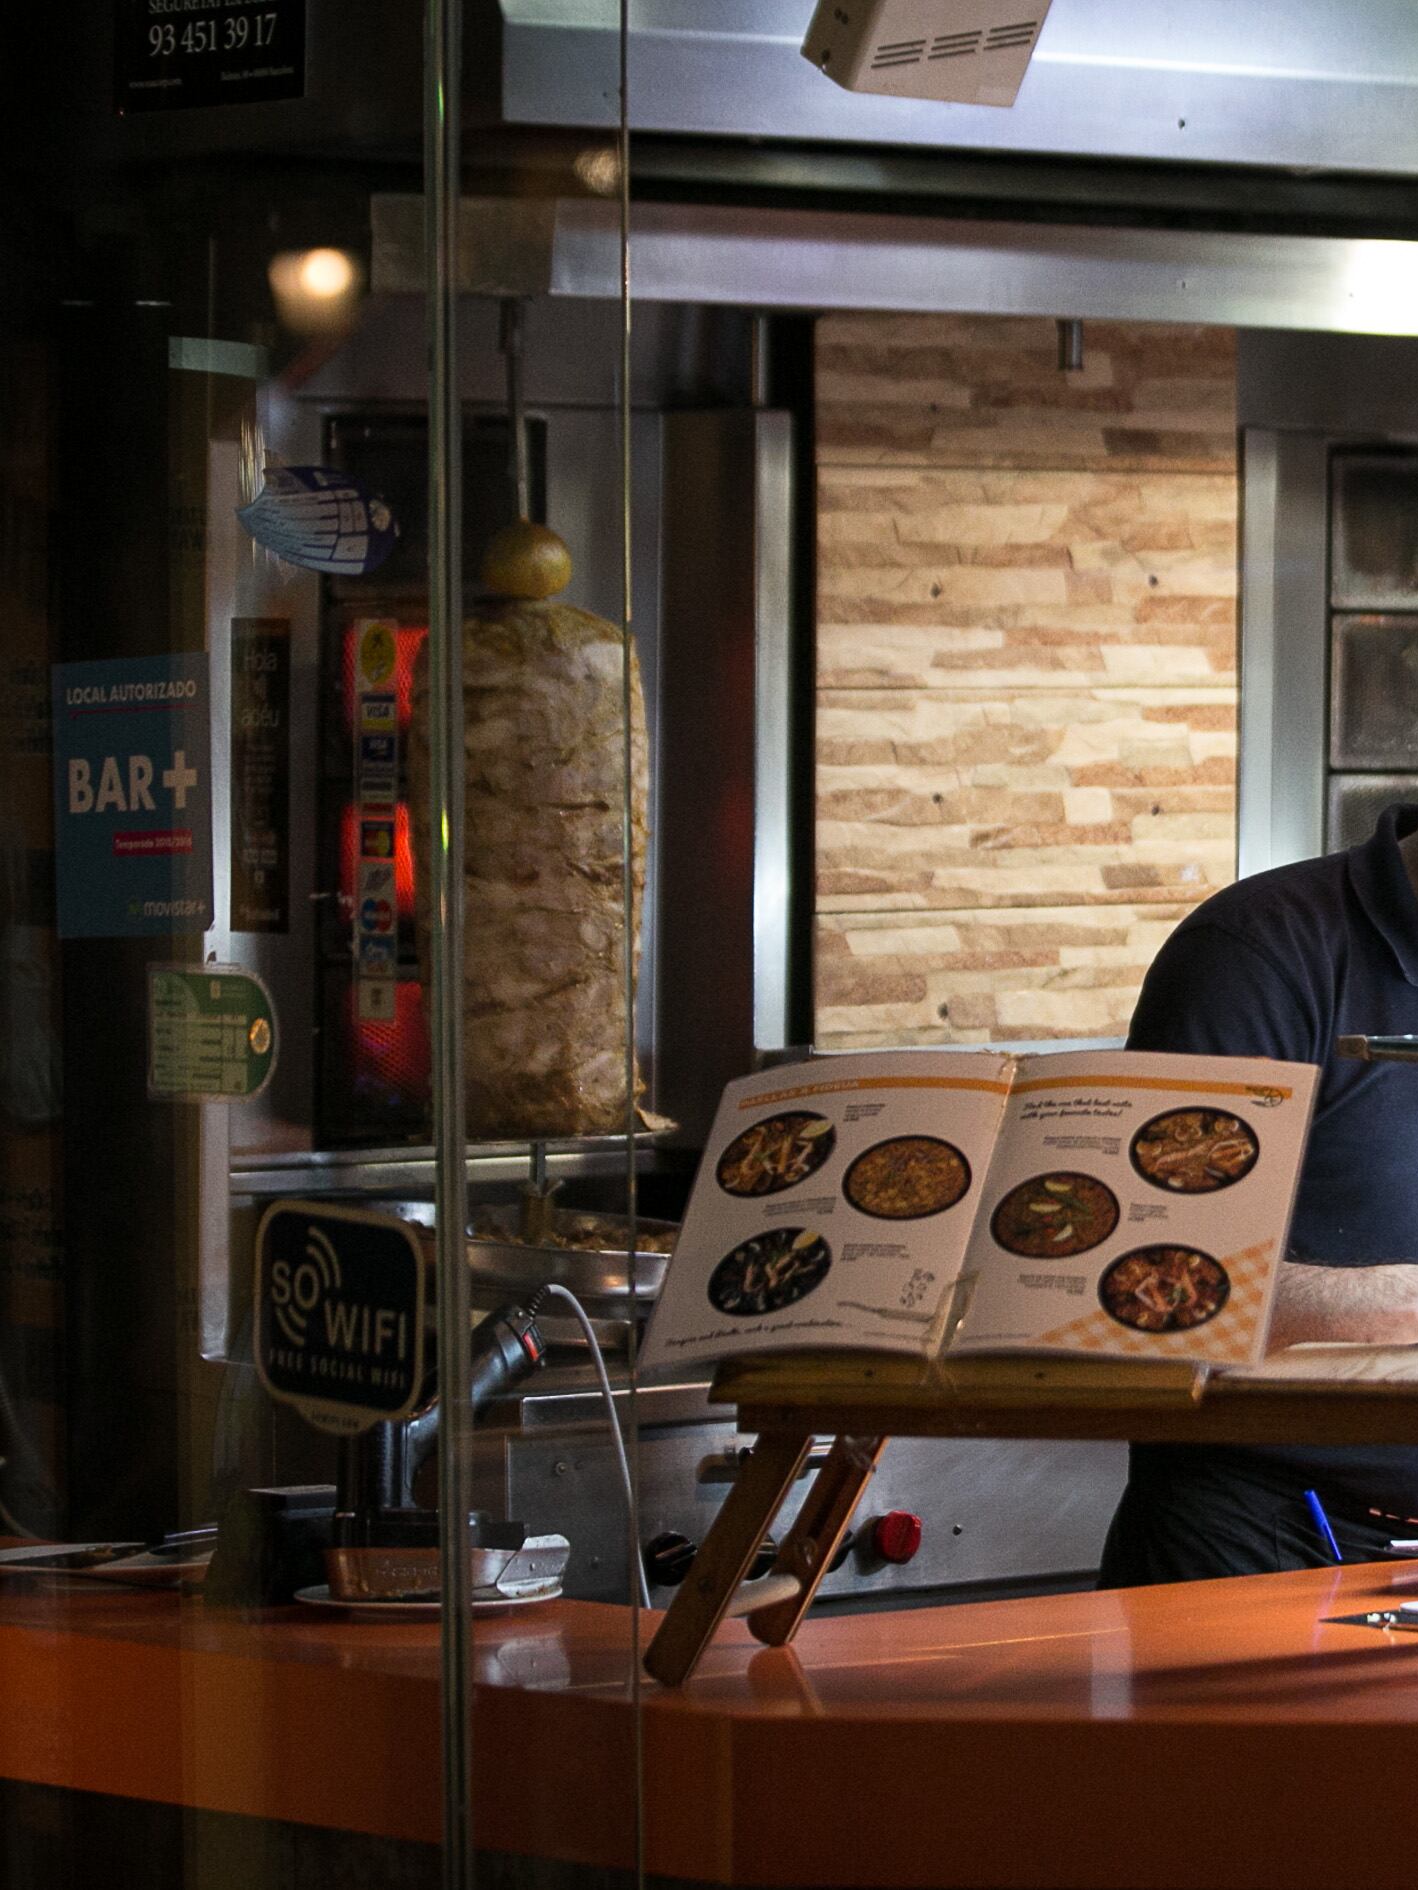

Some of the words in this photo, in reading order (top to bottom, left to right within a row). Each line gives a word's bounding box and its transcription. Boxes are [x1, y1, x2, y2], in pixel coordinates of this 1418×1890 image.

[148, 24, 177, 56] 93
[180, 19, 217, 53] 451
[223, 15, 250, 50] 39
[252, 12, 278, 47] 17
[66, 686, 107, 705] LOCAL
[110, 680, 197, 702] AUTORIZADO
[366, 704, 390, 719] VISA
[271, 1259, 321, 1311] SO
[324, 1298, 408, 1361] WIFI
[310, 1353, 365, 1384] SOCIAL
